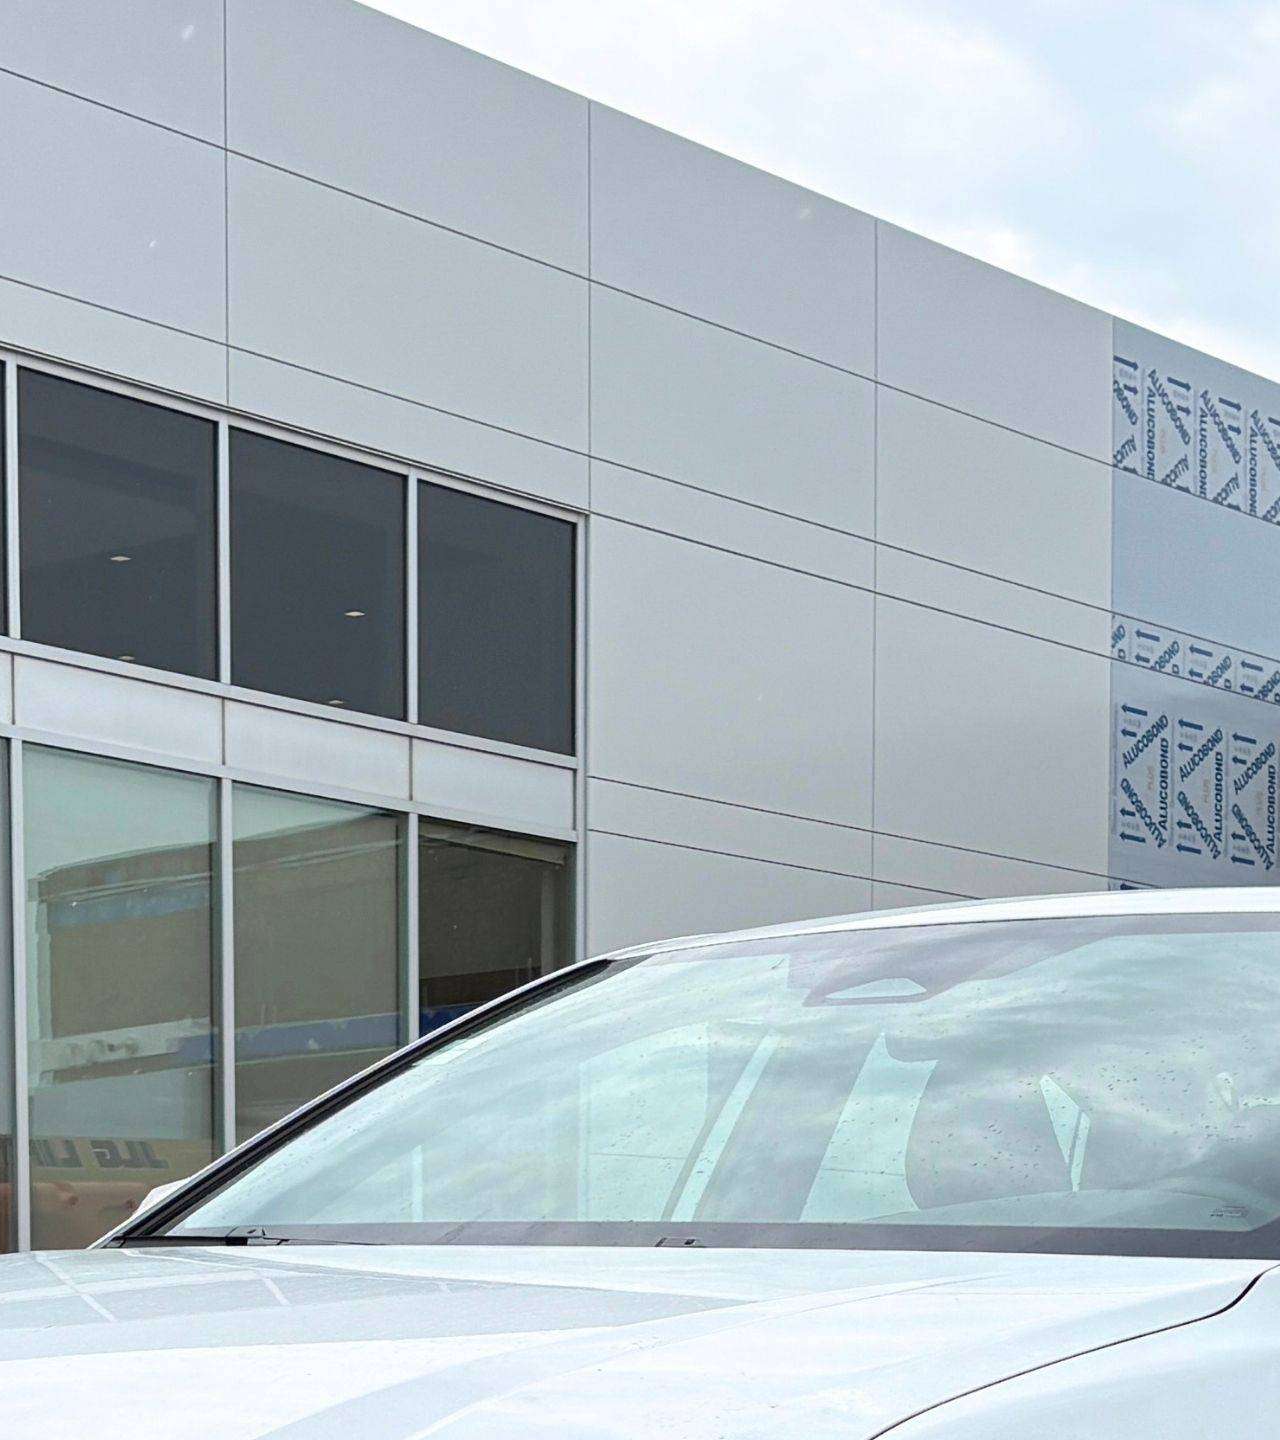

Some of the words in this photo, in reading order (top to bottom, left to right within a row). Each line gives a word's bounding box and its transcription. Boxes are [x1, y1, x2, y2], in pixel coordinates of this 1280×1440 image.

[1146, 386, 1156, 481] ALUCOBOND
[1122, 714, 1169, 769] ALUCOBOND
[1177, 728, 1224, 782] ALUCOBOND
[1233, 742, 1276, 796] ALUCOBOND
[1120, 778, 1167, 849] ALUCOBOND
[1158, 737, 1169, 831] ALUCOBOND
[1213, 752, 1224, 842] ALUCOBOND
[1266, 765, 1276, 854] ALUCOBOND
[1177, 791, 1221, 860] ALUCOBOND
[1231, 803, 1274, 871] ALUCOBOND
